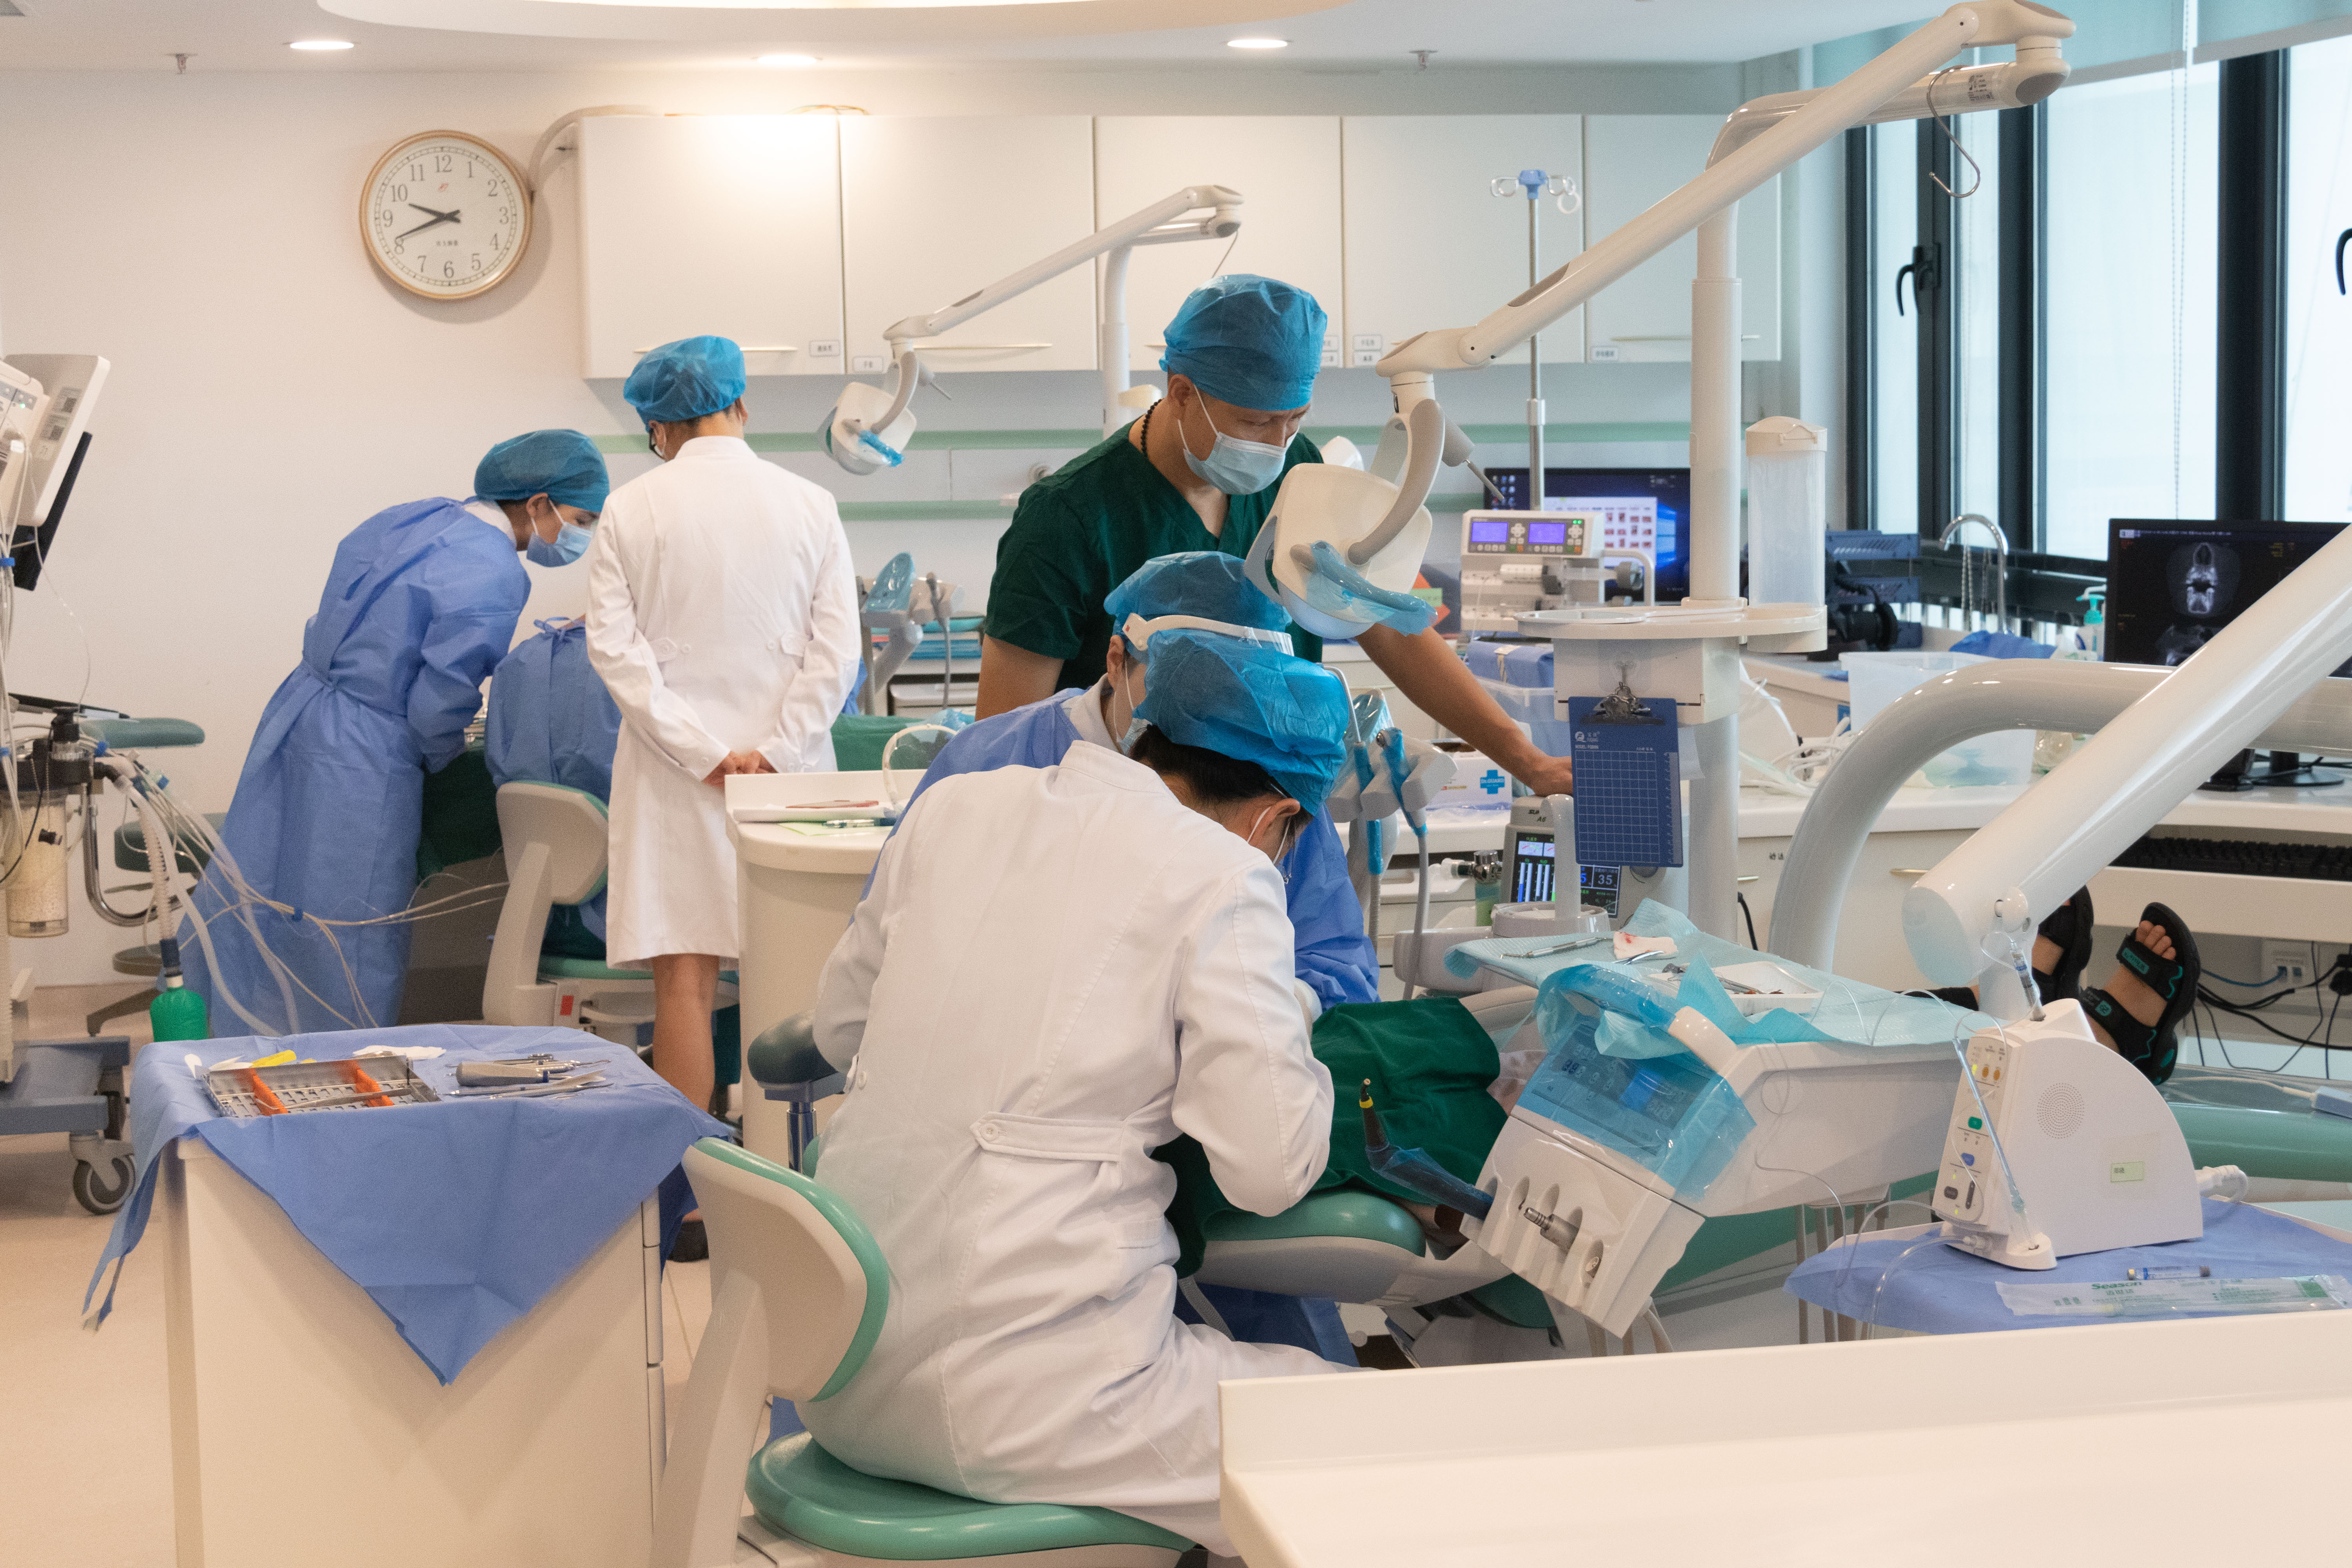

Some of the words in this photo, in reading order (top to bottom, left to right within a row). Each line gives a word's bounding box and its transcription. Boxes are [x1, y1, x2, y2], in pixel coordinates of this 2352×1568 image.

[410, 164, 425, 181] 11
[435, 155, 452, 172] 12
[467, 161, 474, 178] 1
[392, 184, 408, 202] 10
[488, 179, 497, 197] 2
[383, 209, 393, 227] 9
[499, 206, 509, 225] 3
[394, 236, 405, 254] 8
[490, 233, 499, 251] 4
[417, 255, 426, 272] 7
[443, 260, 454, 278] 6
[471, 253, 481, 271] 5
[1598, 874, 1613, 885] 35
